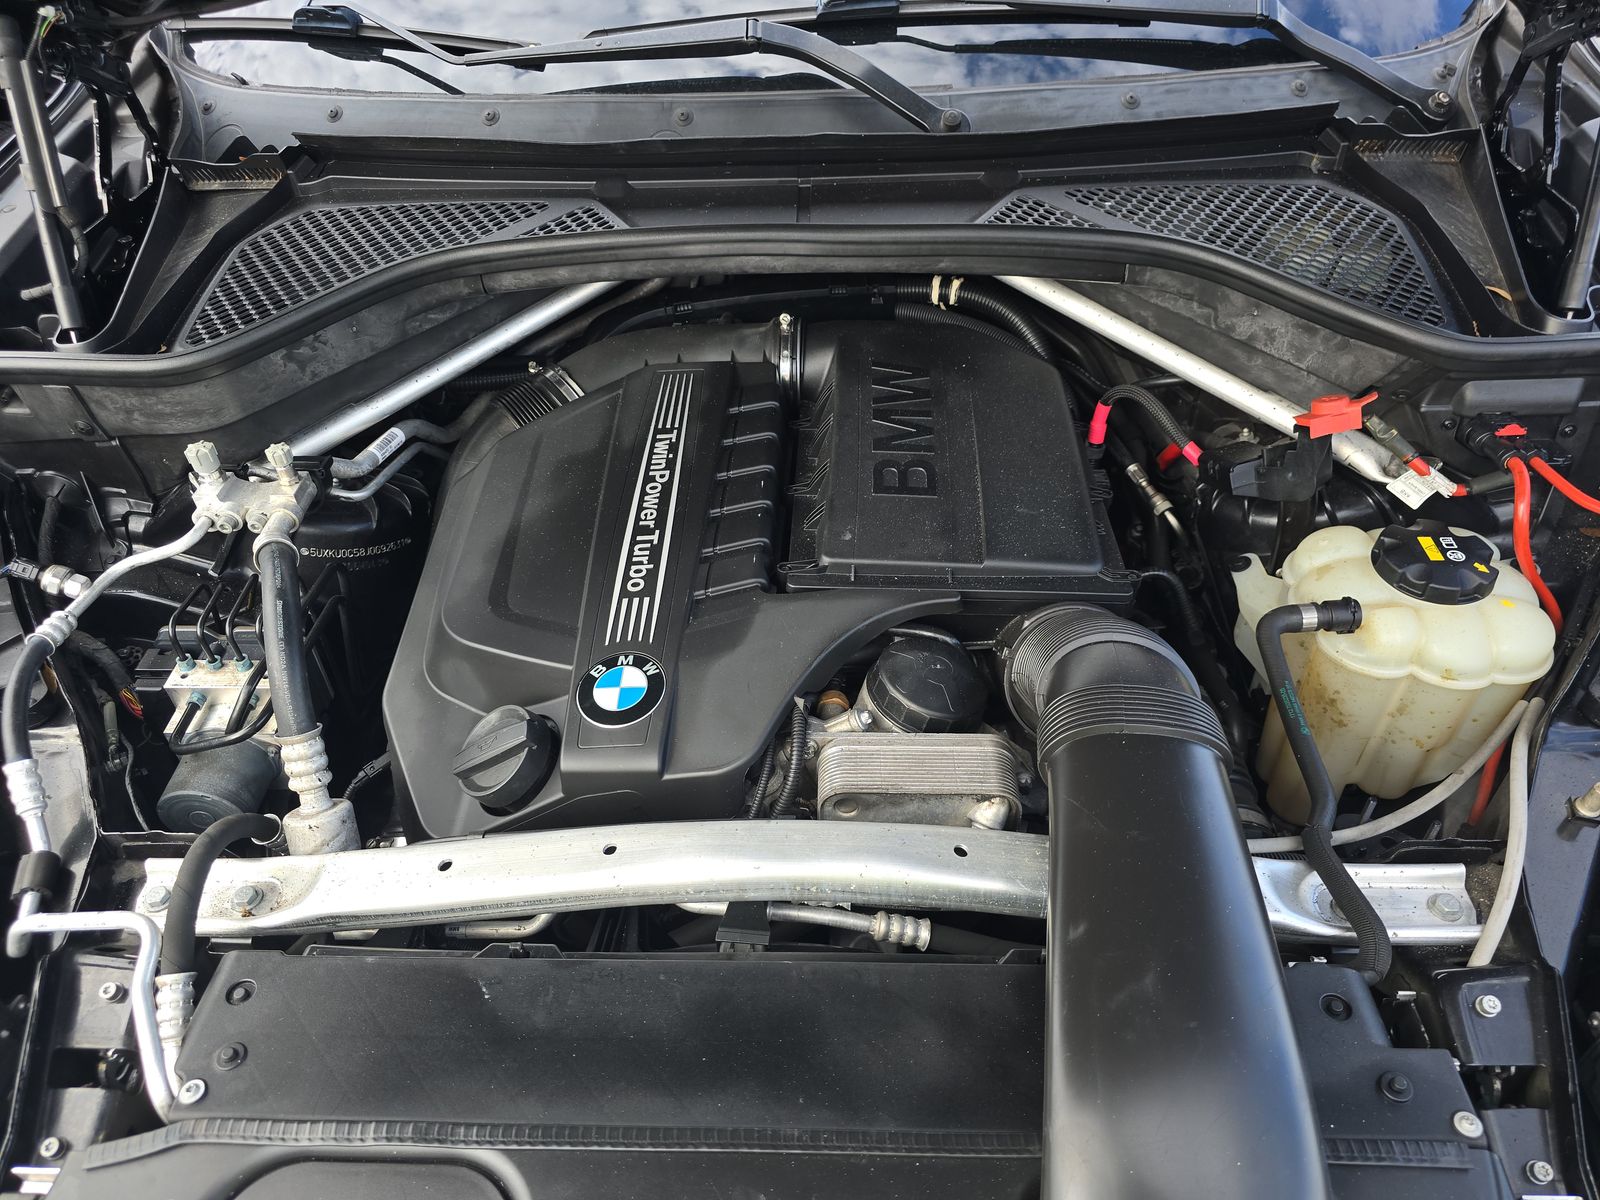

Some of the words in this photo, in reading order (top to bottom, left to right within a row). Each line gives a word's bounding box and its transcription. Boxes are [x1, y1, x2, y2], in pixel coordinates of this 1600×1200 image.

[871, 361, 938, 499] BMW
[638, 428, 678, 530] TwinPower
[626, 530, 660, 592] Turbo
[589, 655, 660, 679] BMW
